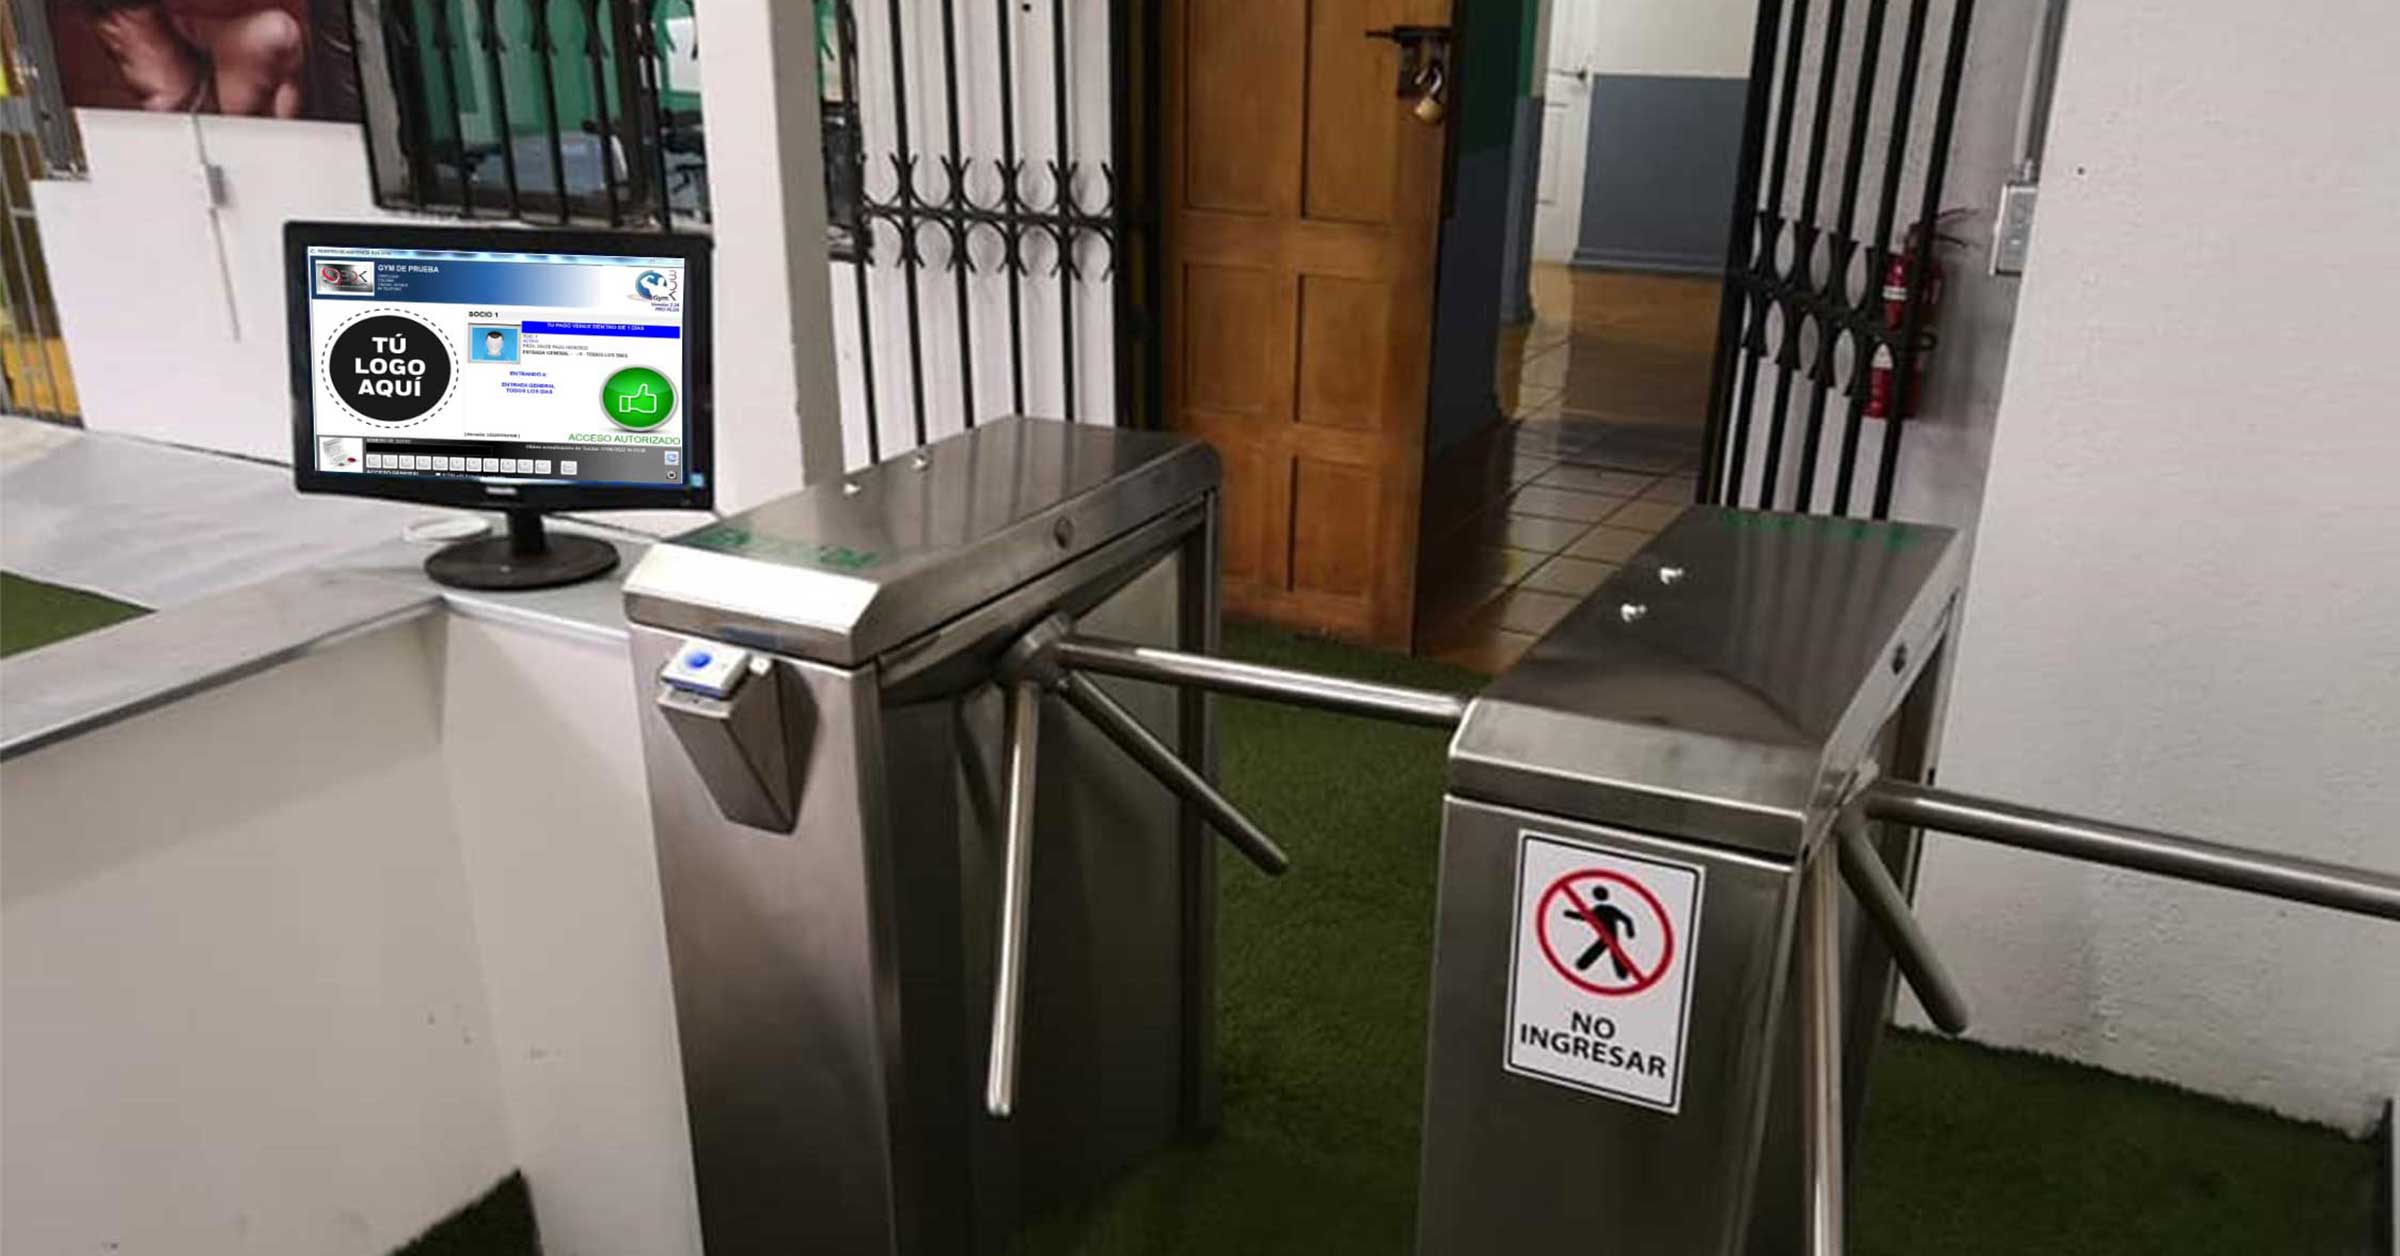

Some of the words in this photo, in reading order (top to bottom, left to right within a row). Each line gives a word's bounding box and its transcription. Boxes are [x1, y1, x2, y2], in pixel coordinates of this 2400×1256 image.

[378, 264, 395, 272] GYM
[408, 265, 439, 273] PRUEBA
[372, 333, 407, 354] TÚ
[355, 357, 426, 376] LOGO
[358, 376, 422, 398] AQUÍ
[568, 433, 612, 443] ACCESO
[613, 434, 681, 446] AUTORIZADO
[1571, 1010, 1616, 1040] NO
[1520, 1023, 1666, 1079] INGRESAR
